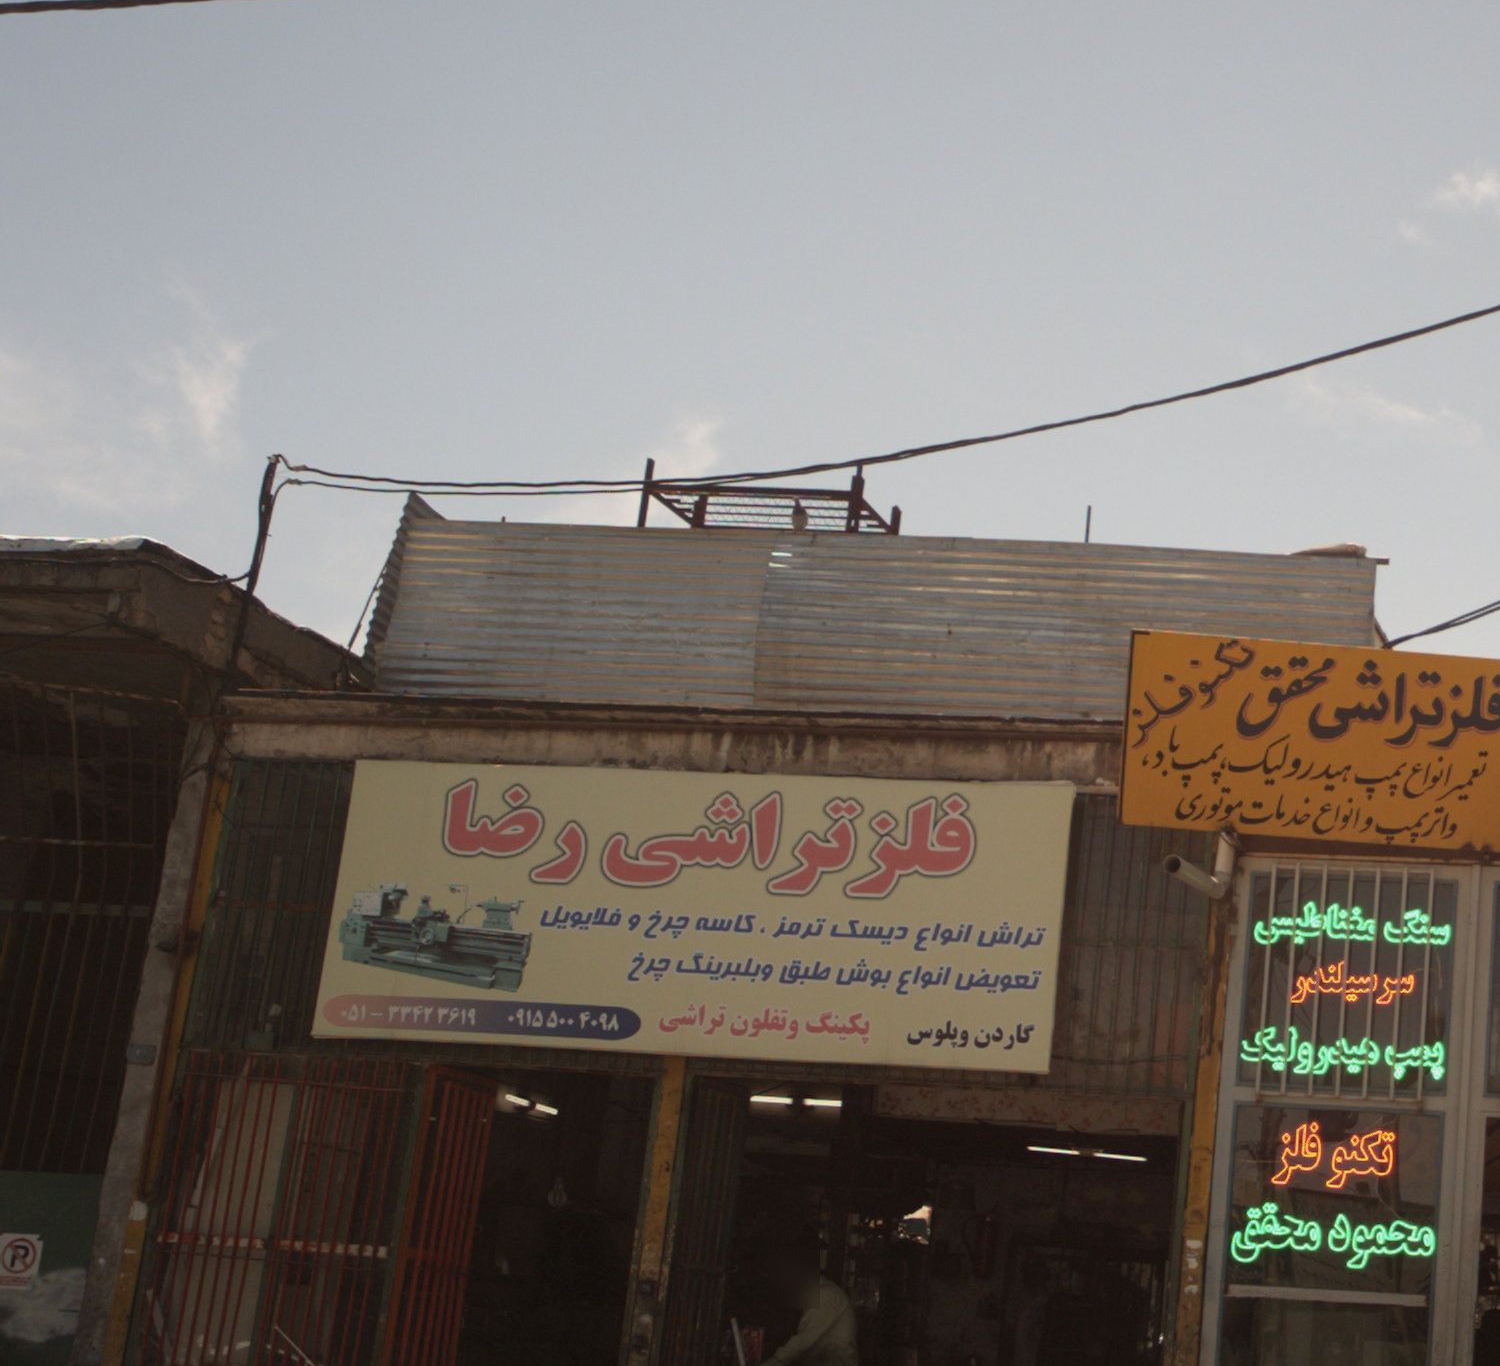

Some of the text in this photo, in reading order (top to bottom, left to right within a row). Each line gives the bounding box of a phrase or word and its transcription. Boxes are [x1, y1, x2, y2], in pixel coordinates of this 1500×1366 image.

[1236, 655, 1336, 739] محقق
[1171, 742, 1223, 787] پمپ
[1403, 756, 1452, 799] انواع
[1435, 751, 1488, 801] تعمیر
[1354, 761, 1406, 799] پمپ
[1175, 787, 1243, 822] موتوری
[1239, 794, 1310, 827] خدمات
[1311, 797, 1360, 835] انواع
[443, 778, 588, 884] رضا
[1363, 815, 1373, 832] و
[540, 904, 622, 931] فلایویل
[628, 916, 641, 932] و
[642, 909, 691, 940] چرخ
[695, 914, 756, 934] کاسه
[772, 915, 827, 939] ترمز
[829, 918, 909, 946] دیسک
[912, 922, 973, 951] انواع
[976, 921, 1046, 947] تراش
[626, 952, 673, 982] چرخ
[779, 958, 832, 986] طبق
[835, 959, 893, 989] بوش
[895, 966, 952, 996] انواع
[955, 969, 1043, 994] تعویض
[659, 1003, 727, 1036] تراشی
[804, 1012, 871, 1045] پکینگ
[973, 1023, 1035, 1050] گاردن
[1270, 1121, 1396, 1188] تکنو فلز
[1230, 1201, 1437, 1270] محمود محقق
